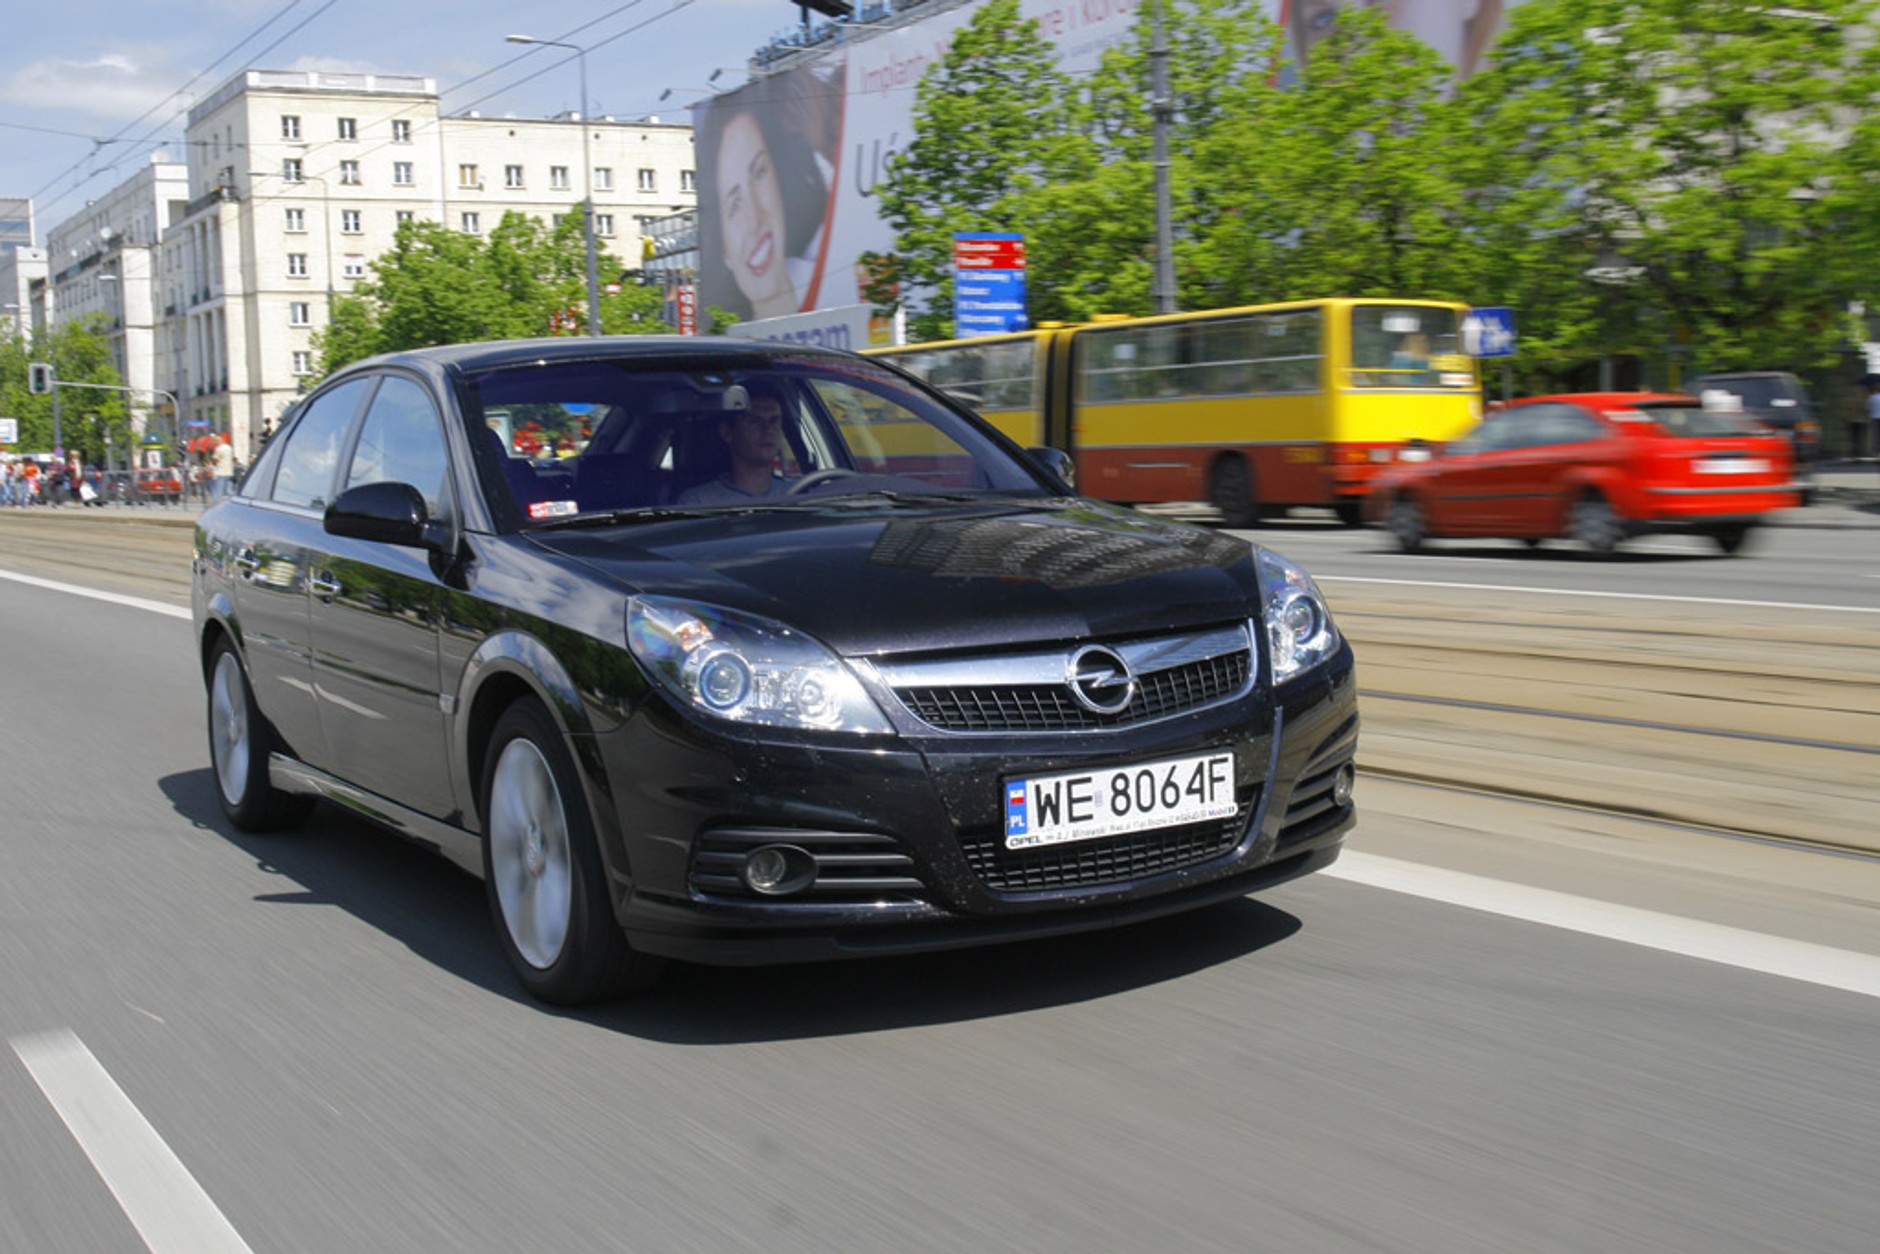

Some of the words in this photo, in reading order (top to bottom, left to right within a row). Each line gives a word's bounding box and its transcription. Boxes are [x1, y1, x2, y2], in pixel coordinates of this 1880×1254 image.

[1034, 776, 1094, 828] WE
[1111, 757, 1229, 816] 8064F
[1009, 815, 1026, 828] PL
